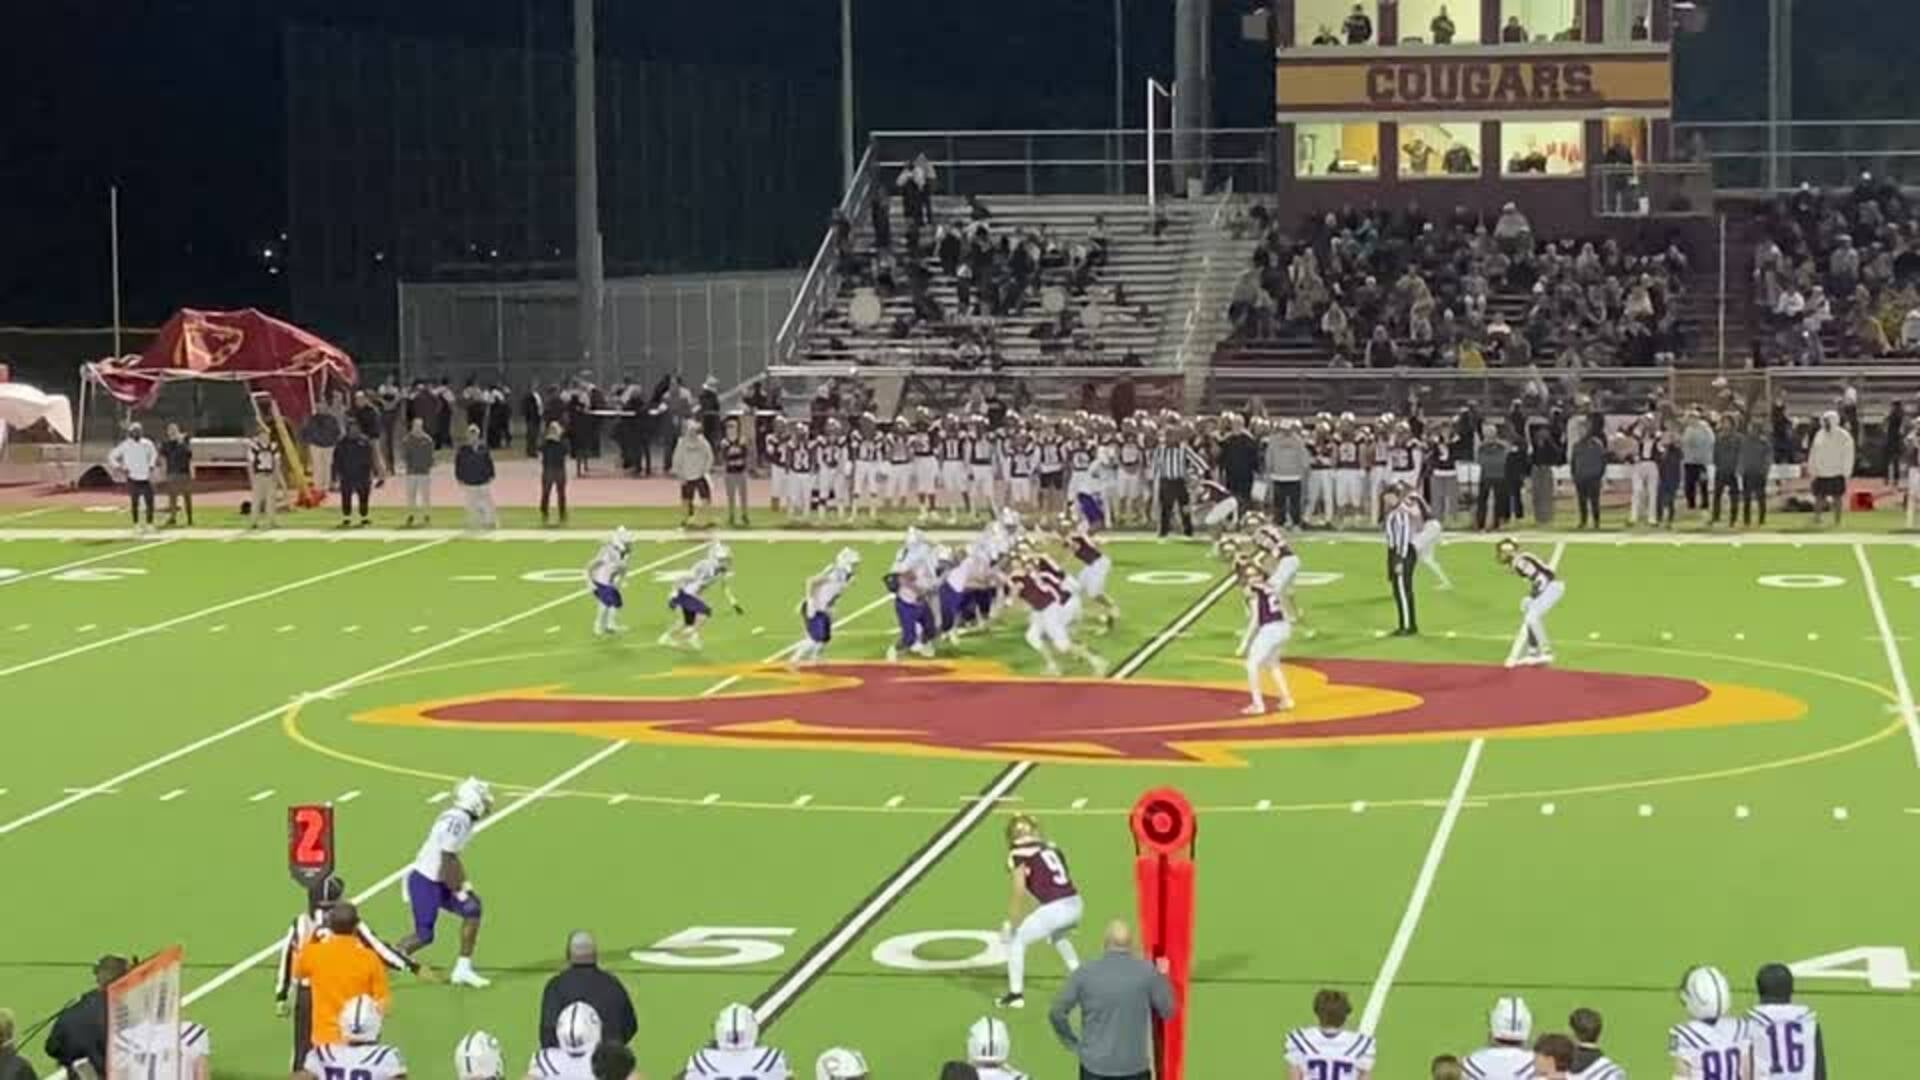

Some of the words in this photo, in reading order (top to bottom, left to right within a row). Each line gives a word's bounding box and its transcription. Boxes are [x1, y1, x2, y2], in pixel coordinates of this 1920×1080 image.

[1366, 62, 1594, 101] COUGARS
[296, 808, 326, 863] 2
[1040, 848, 1069, 886] 9
[630, 927, 1009, 970] 50
[1765, 1021, 1805, 1074] 16
